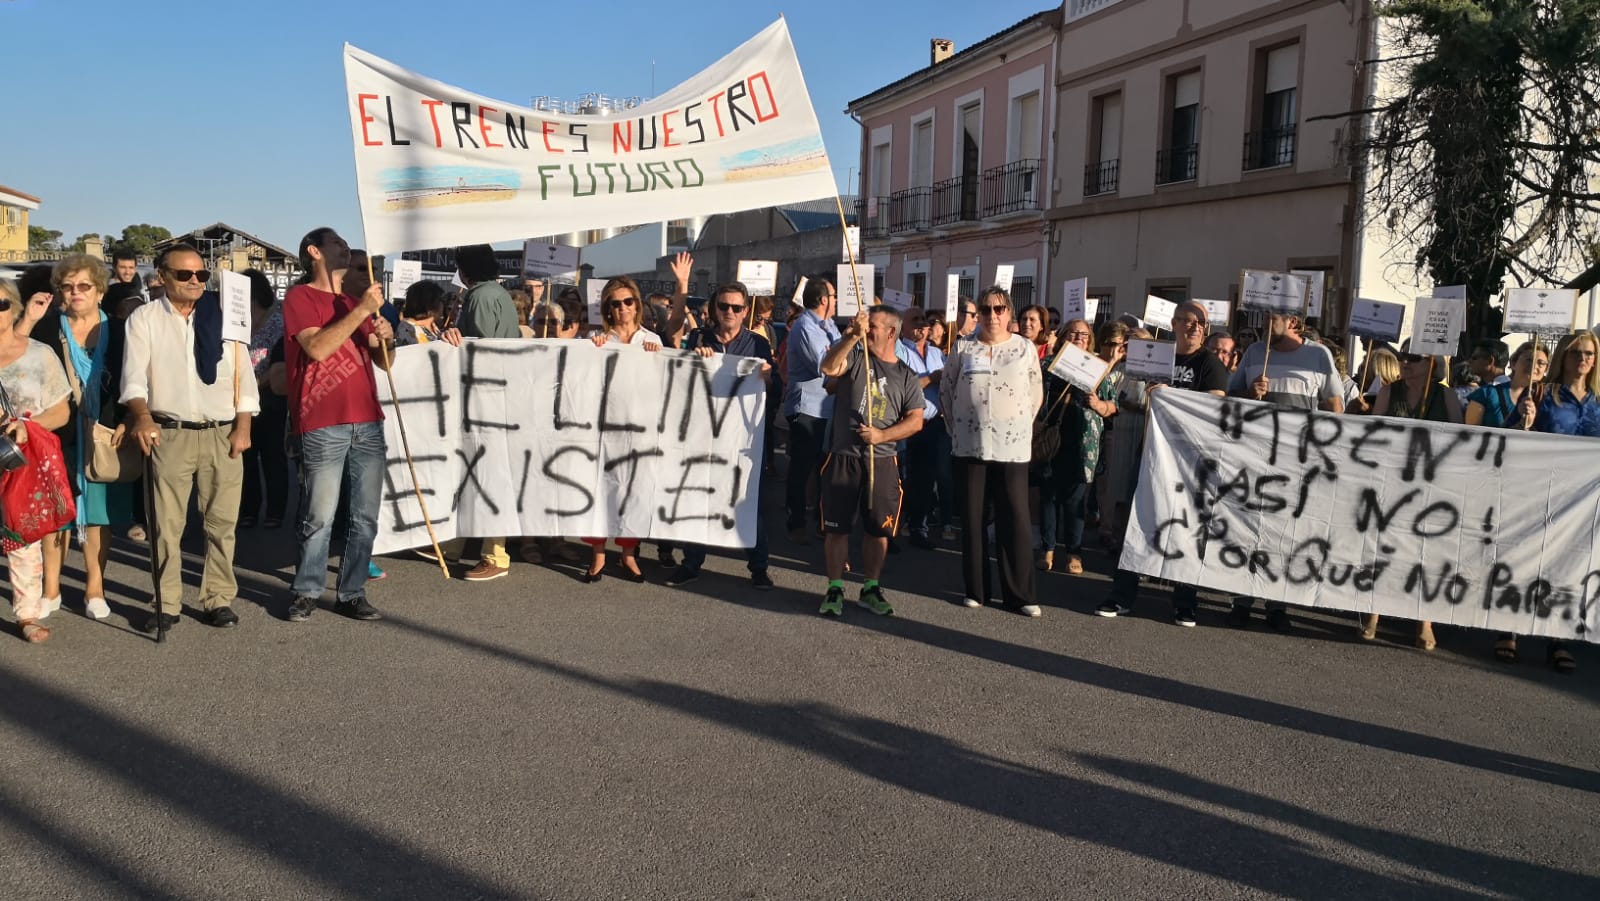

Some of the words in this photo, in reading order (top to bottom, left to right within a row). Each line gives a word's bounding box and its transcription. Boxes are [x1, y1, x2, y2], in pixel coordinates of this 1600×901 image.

[358, 93, 411, 146] EL
[421, 99, 529, 150] TREN
[542, 120, 589, 153] ES
[612, 70, 779, 155] NUESTRO
[537, 158, 705, 201] FUTURO
[384, 444, 742, 532] EXISTE!
